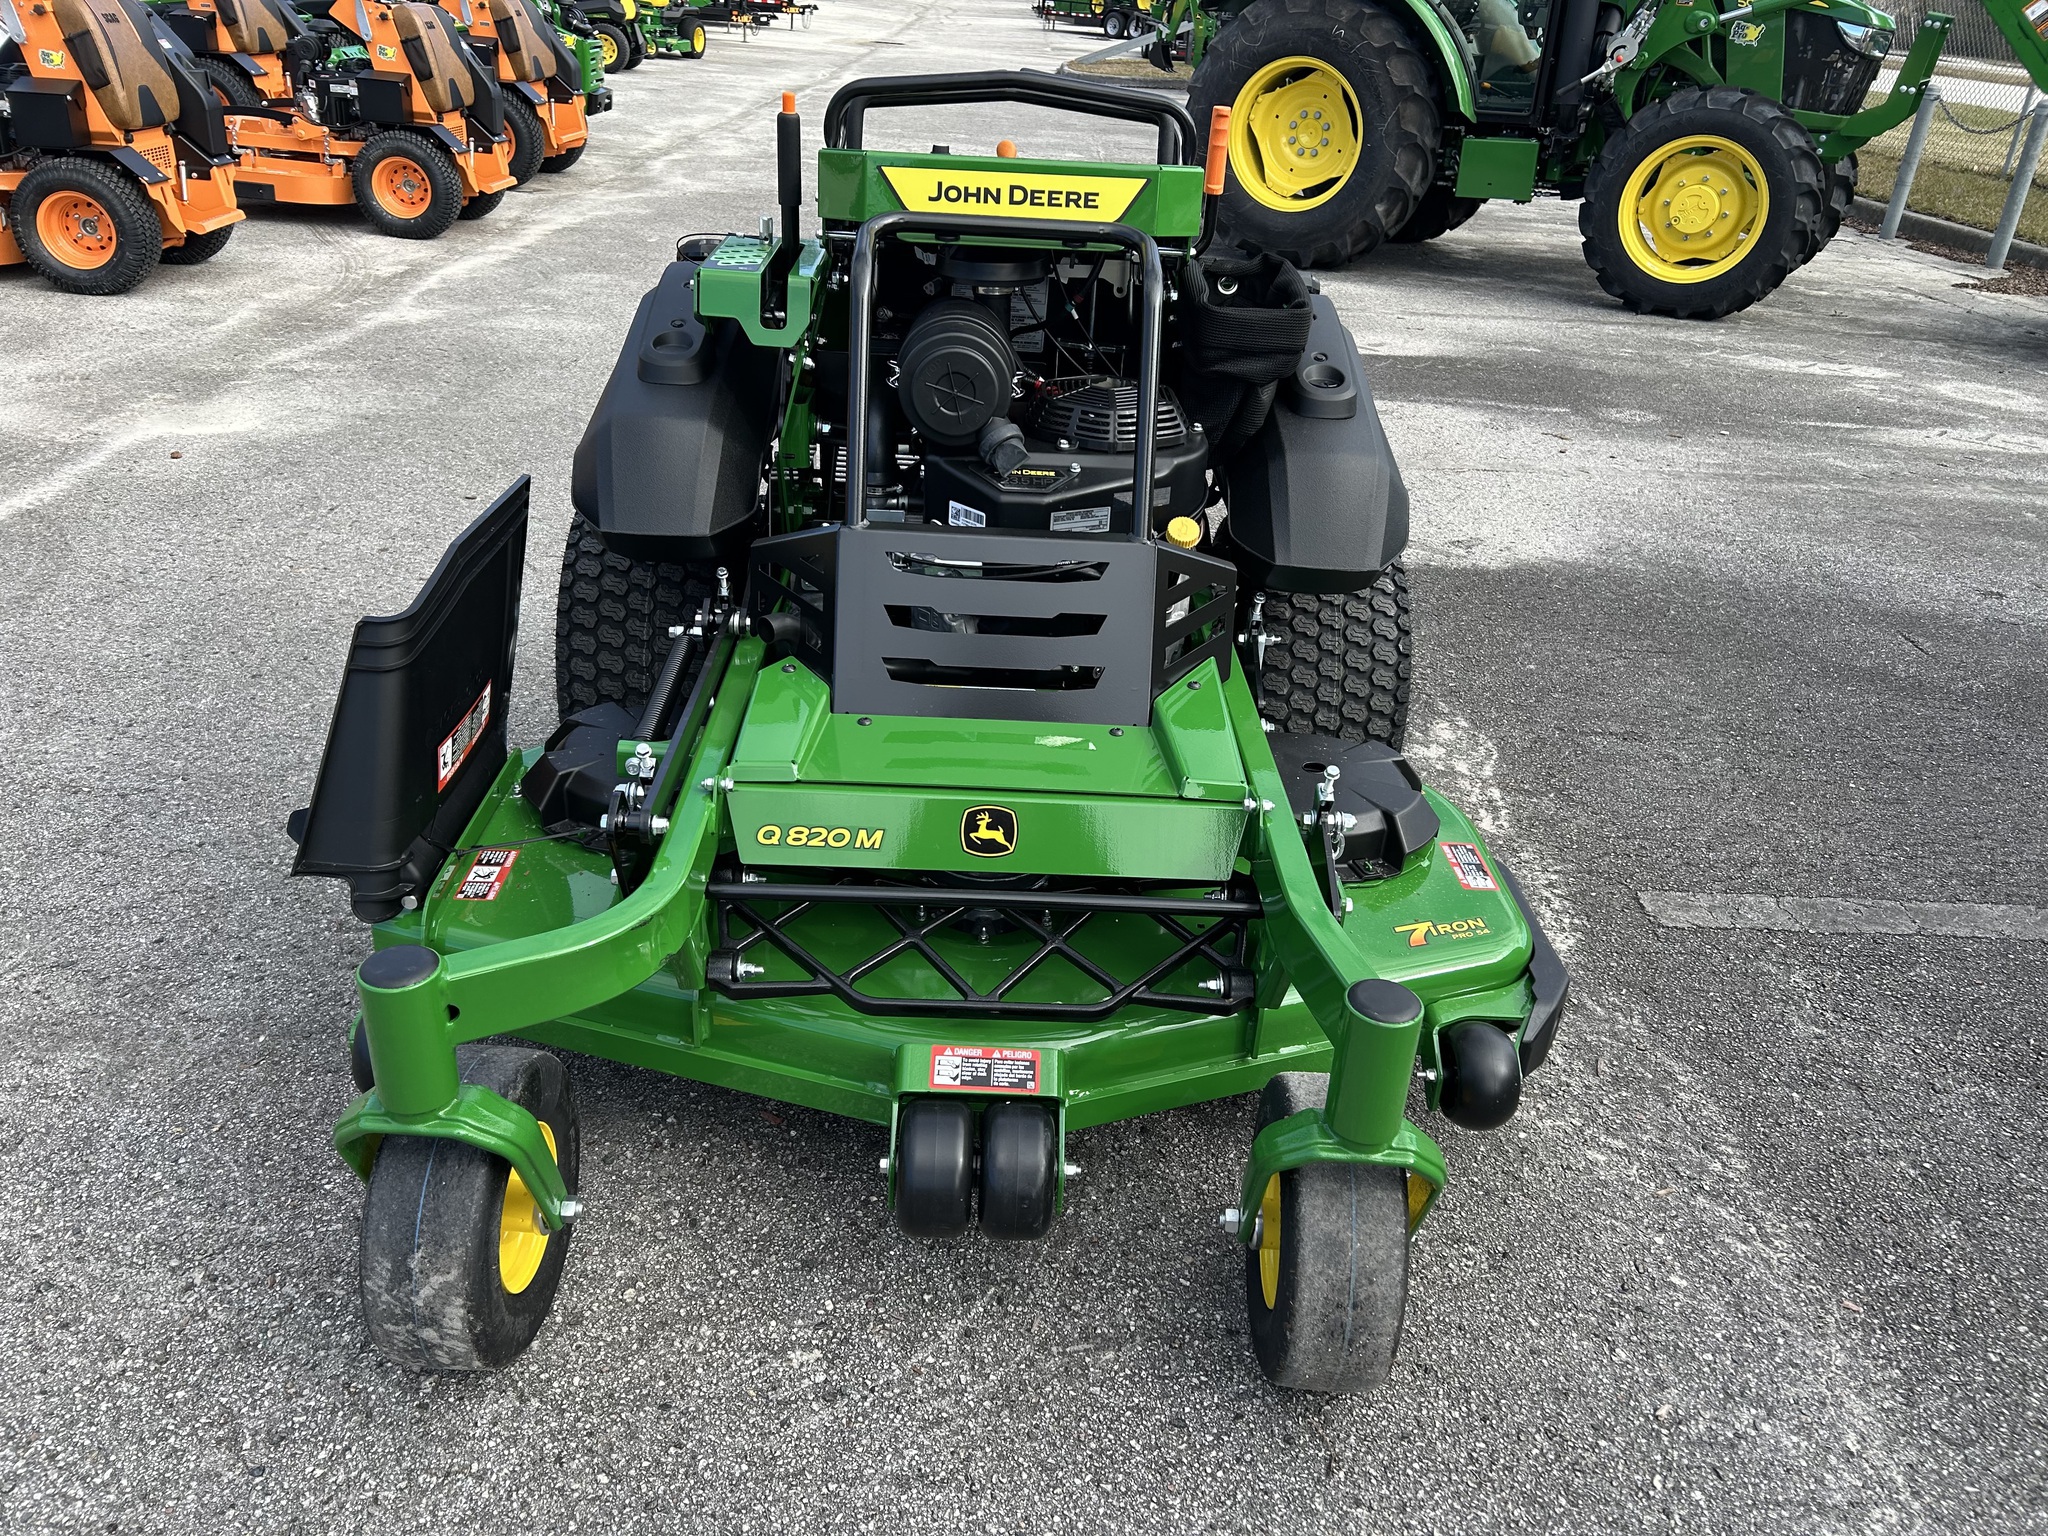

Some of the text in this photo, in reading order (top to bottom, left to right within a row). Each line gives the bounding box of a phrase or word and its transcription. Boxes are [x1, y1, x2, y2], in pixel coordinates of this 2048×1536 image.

[928, 181, 1100, 209] JOHN DEERE
[1022, 469, 1056, 477] DEERE
[756, 824, 885, 850] Q 820 M
[1452, 931, 1474, 940] PRO
[954, 1048, 983, 1056] DANGER
[1002, 1050, 1032, 1059] PELIGRO
